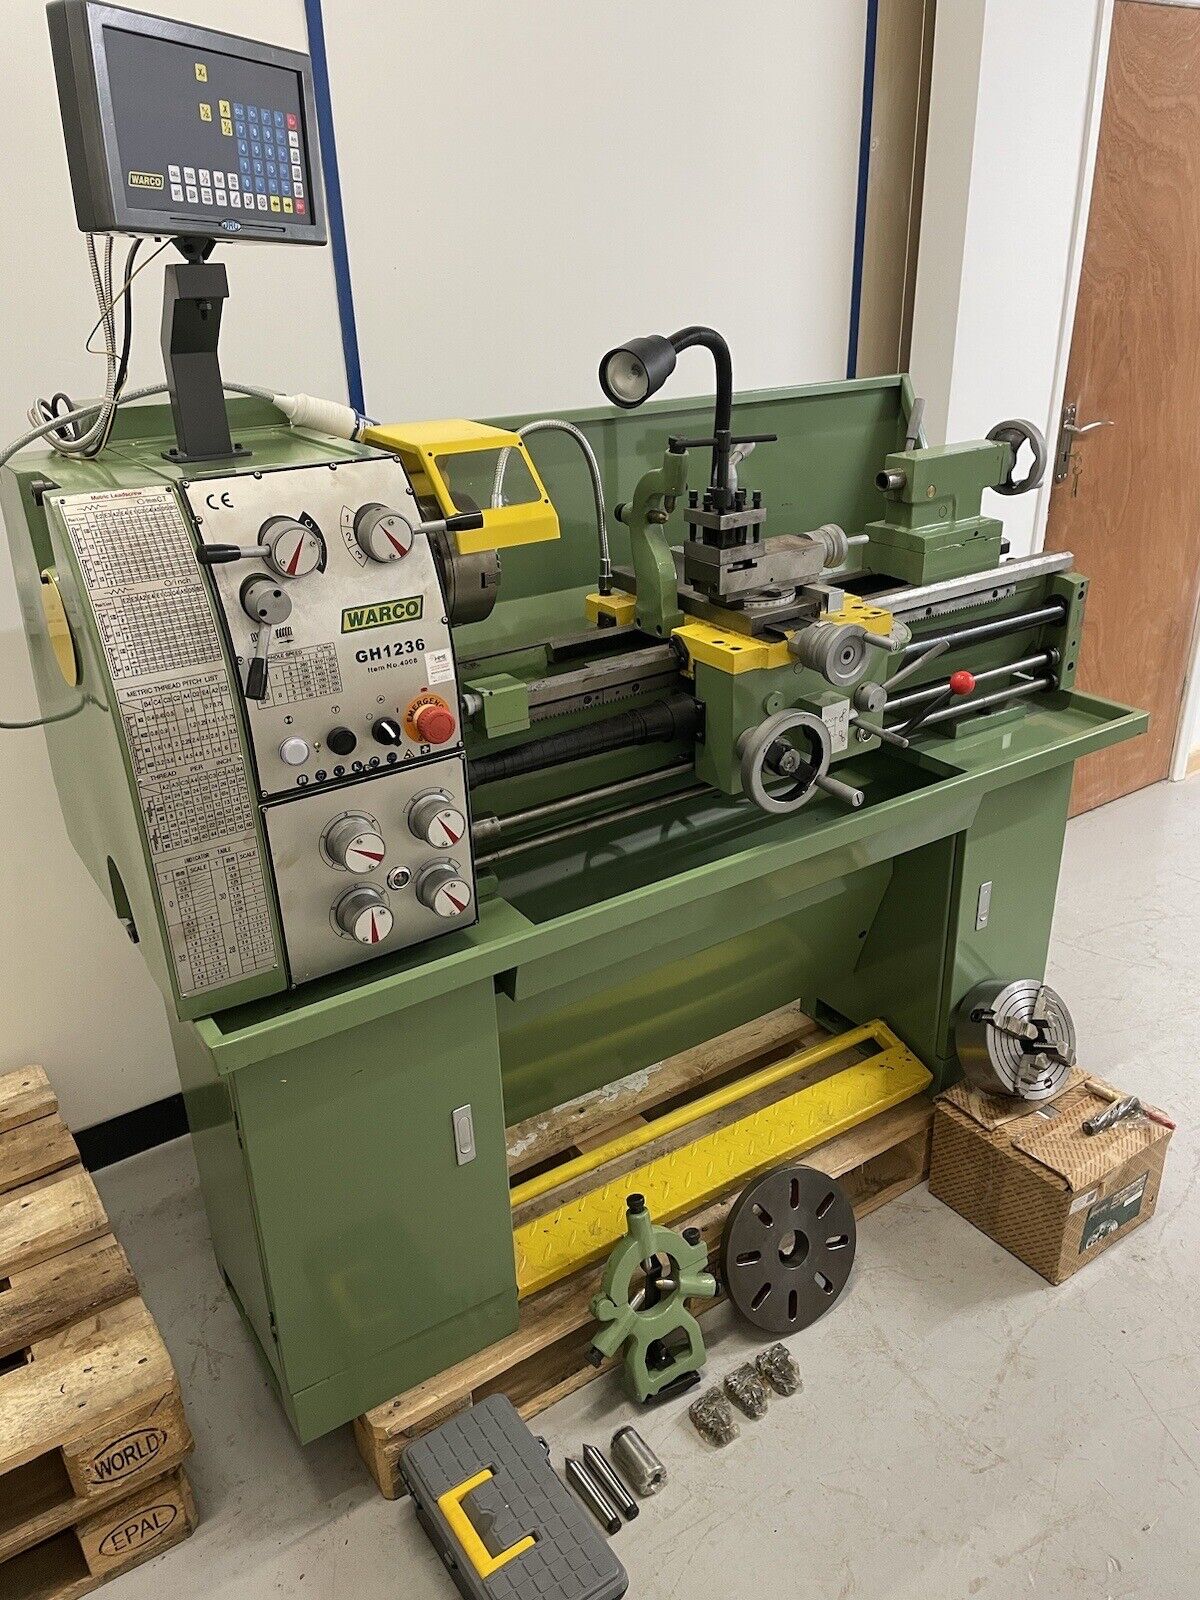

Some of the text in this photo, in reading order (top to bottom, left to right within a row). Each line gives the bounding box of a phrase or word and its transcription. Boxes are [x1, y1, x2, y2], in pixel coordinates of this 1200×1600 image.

[132, 174, 161, 186] WARCO
[346, 532, 353, 542] 2
[355, 550, 363, 559] 3
[347, 600, 419, 628] WARCO
[356, 638, 425, 663] GH1236
[126, 689, 153, 698] METRIC
[154, 682, 180, 692] THREAD
[182, 678, 201, 687] PITCH
[150, 770, 177, 780] THREAD
[217, 846, 231, 854] TABLE
[189, 864, 206, 873] SCALE
[239, 851, 255, 859] SCALE
[94, 1432, 159, 1480] WORLD
[111, 1512, 168, 1552] EPAL
